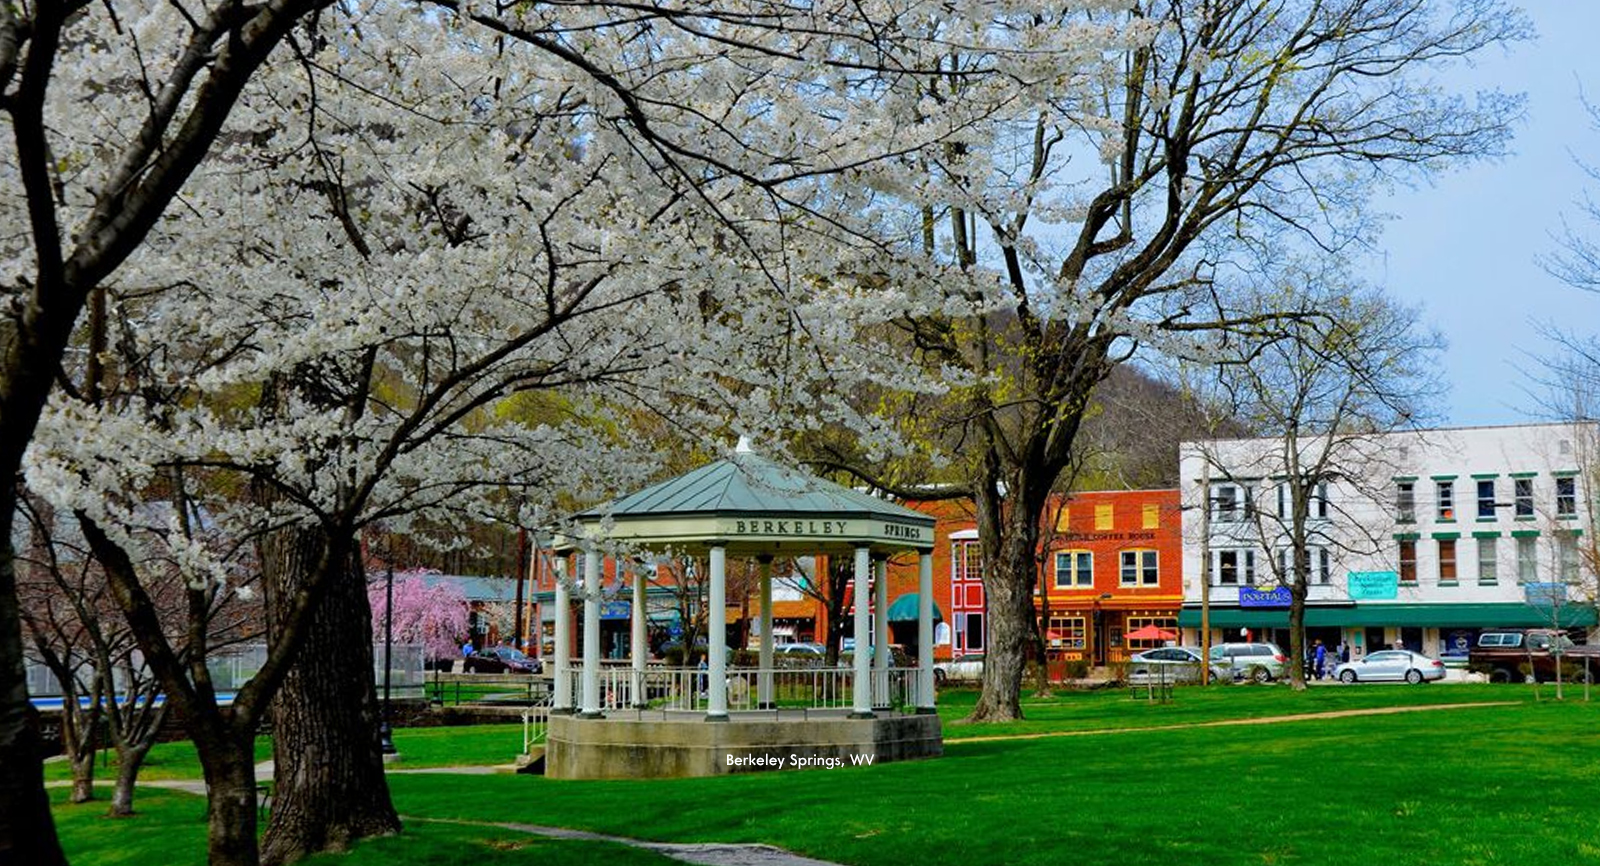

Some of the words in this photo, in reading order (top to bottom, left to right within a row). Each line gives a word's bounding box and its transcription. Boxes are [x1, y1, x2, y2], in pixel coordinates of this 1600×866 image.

[736, 521, 847, 534] BERKELEY
[884, 523, 920, 539] SPRINGS
[1128, 532, 1156, 540] HOUSE
